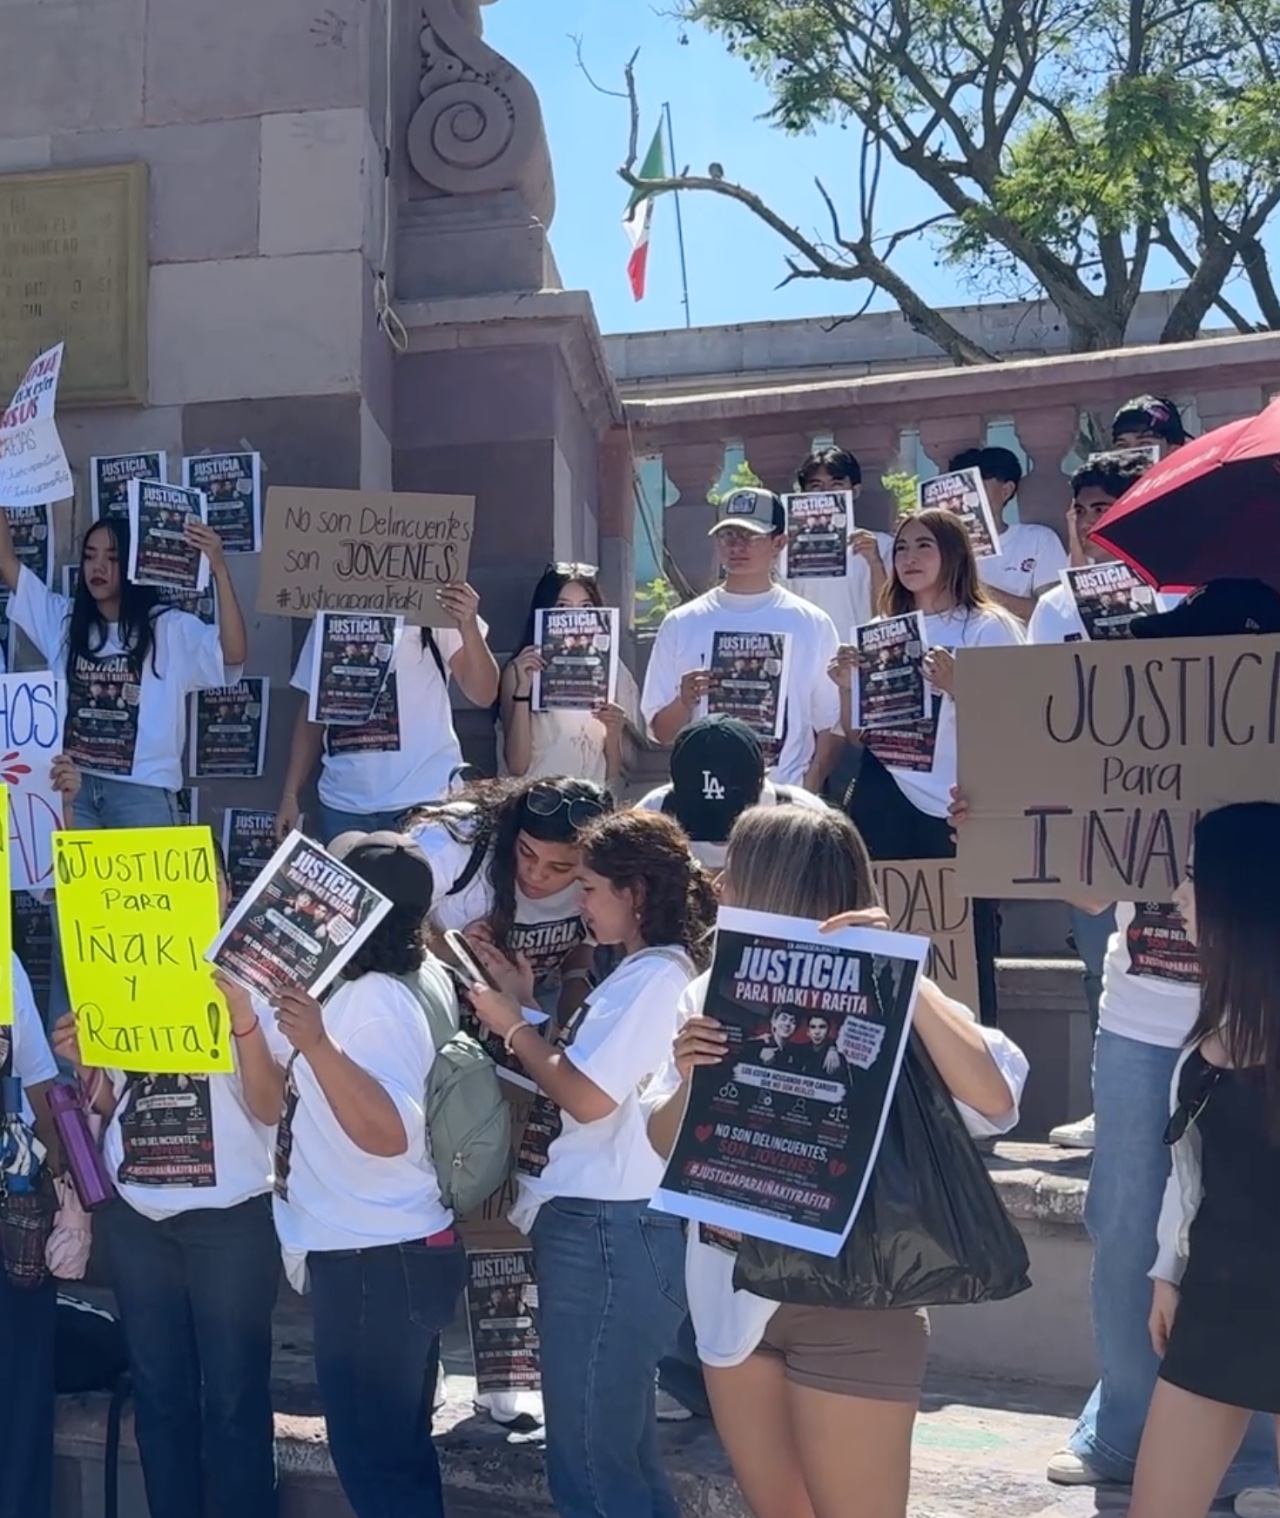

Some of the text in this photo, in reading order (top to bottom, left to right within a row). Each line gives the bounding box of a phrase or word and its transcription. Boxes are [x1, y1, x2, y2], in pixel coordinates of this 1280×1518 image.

[102, 458, 147, 475] JUSTICIA
[194, 458, 240, 476] JUSTICIA
[143, 487, 188, 503] JUSTICIA
[924, 475, 964, 499] JUSTICIA
[792, 496, 835, 511] JUSTICIA
[285, 507, 311, 532] No
[317, 511, 351, 533] son
[285, 540, 459, 584] son JOVENES
[1074, 566, 1131, 590] JUSTICIA
[328, 619, 379, 633] JUSTICIA
[547, 612, 597, 628] JUSTICIA
[718, 636, 770, 650] JUSTICIA
[863, 621, 907, 645] JUSTICIA
[1045, 653, 1280, 751] JUSTICI
[1103, 756, 1181, 800] Para
[292, 851, 360, 905] JUSTICIA
[734, 947, 860, 992] JUSTICIA
[735, 982, 868, 1014] PARA IÑAKI Y RAFITA
[715, 1123, 828, 1162] NO SON DELINCUENTES,
[719, 1140, 749, 1156] SON
[689, 1163, 831, 1210] #JUSTICIAPARAIÑAKIYRAFITA
[471, 1256, 525, 1278] JUSTICIA
